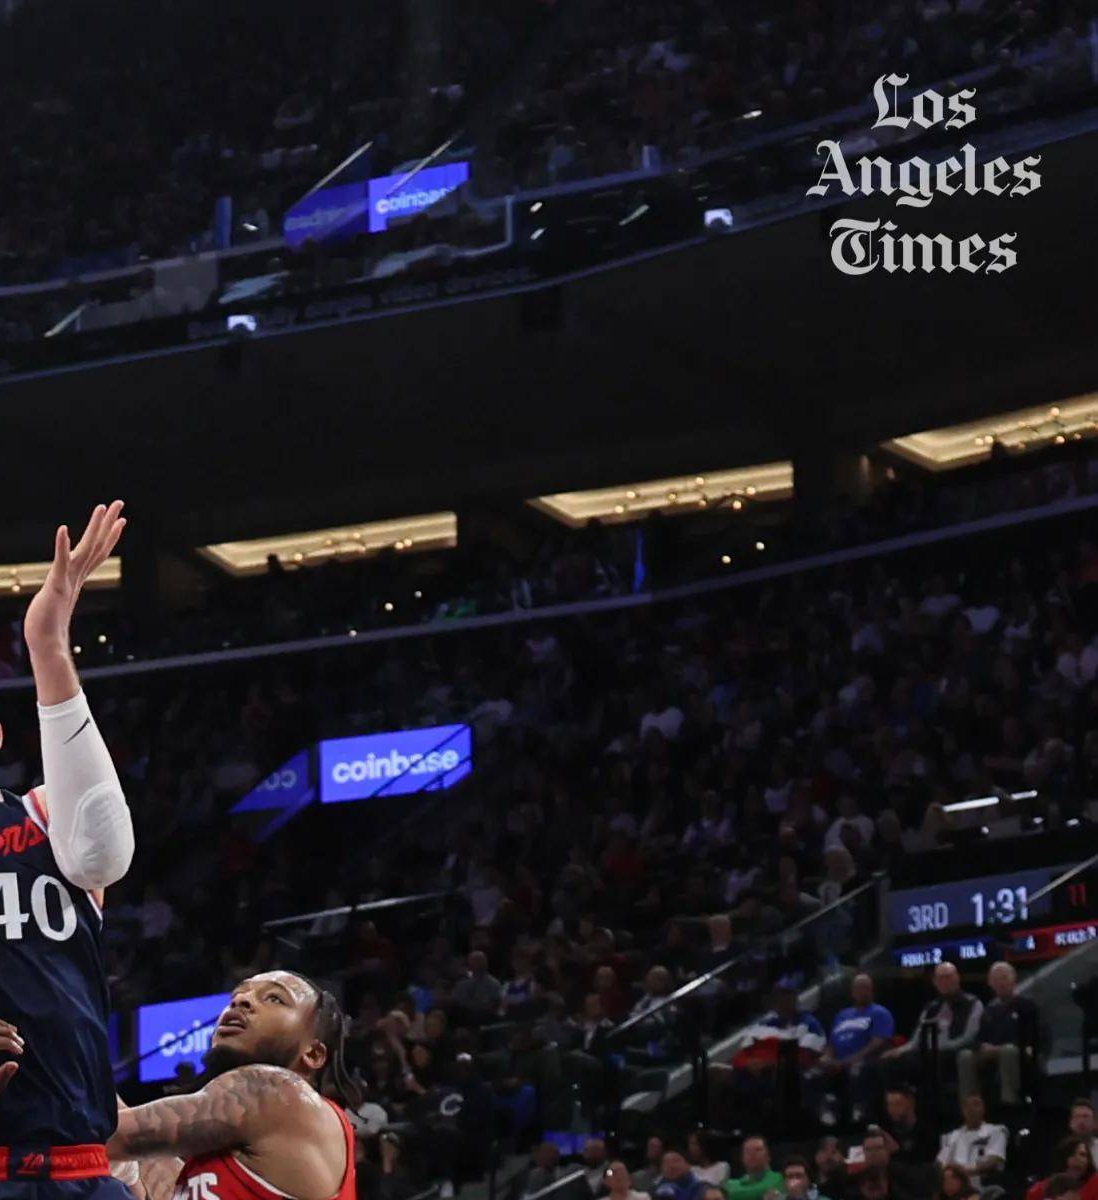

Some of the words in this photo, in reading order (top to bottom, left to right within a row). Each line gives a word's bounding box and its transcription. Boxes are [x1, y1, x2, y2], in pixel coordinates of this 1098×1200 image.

[331, 749, 461, 783] coinbase
[908, 902, 949, 933] 3RD
[970, 886, 1029, 928] 1:31
